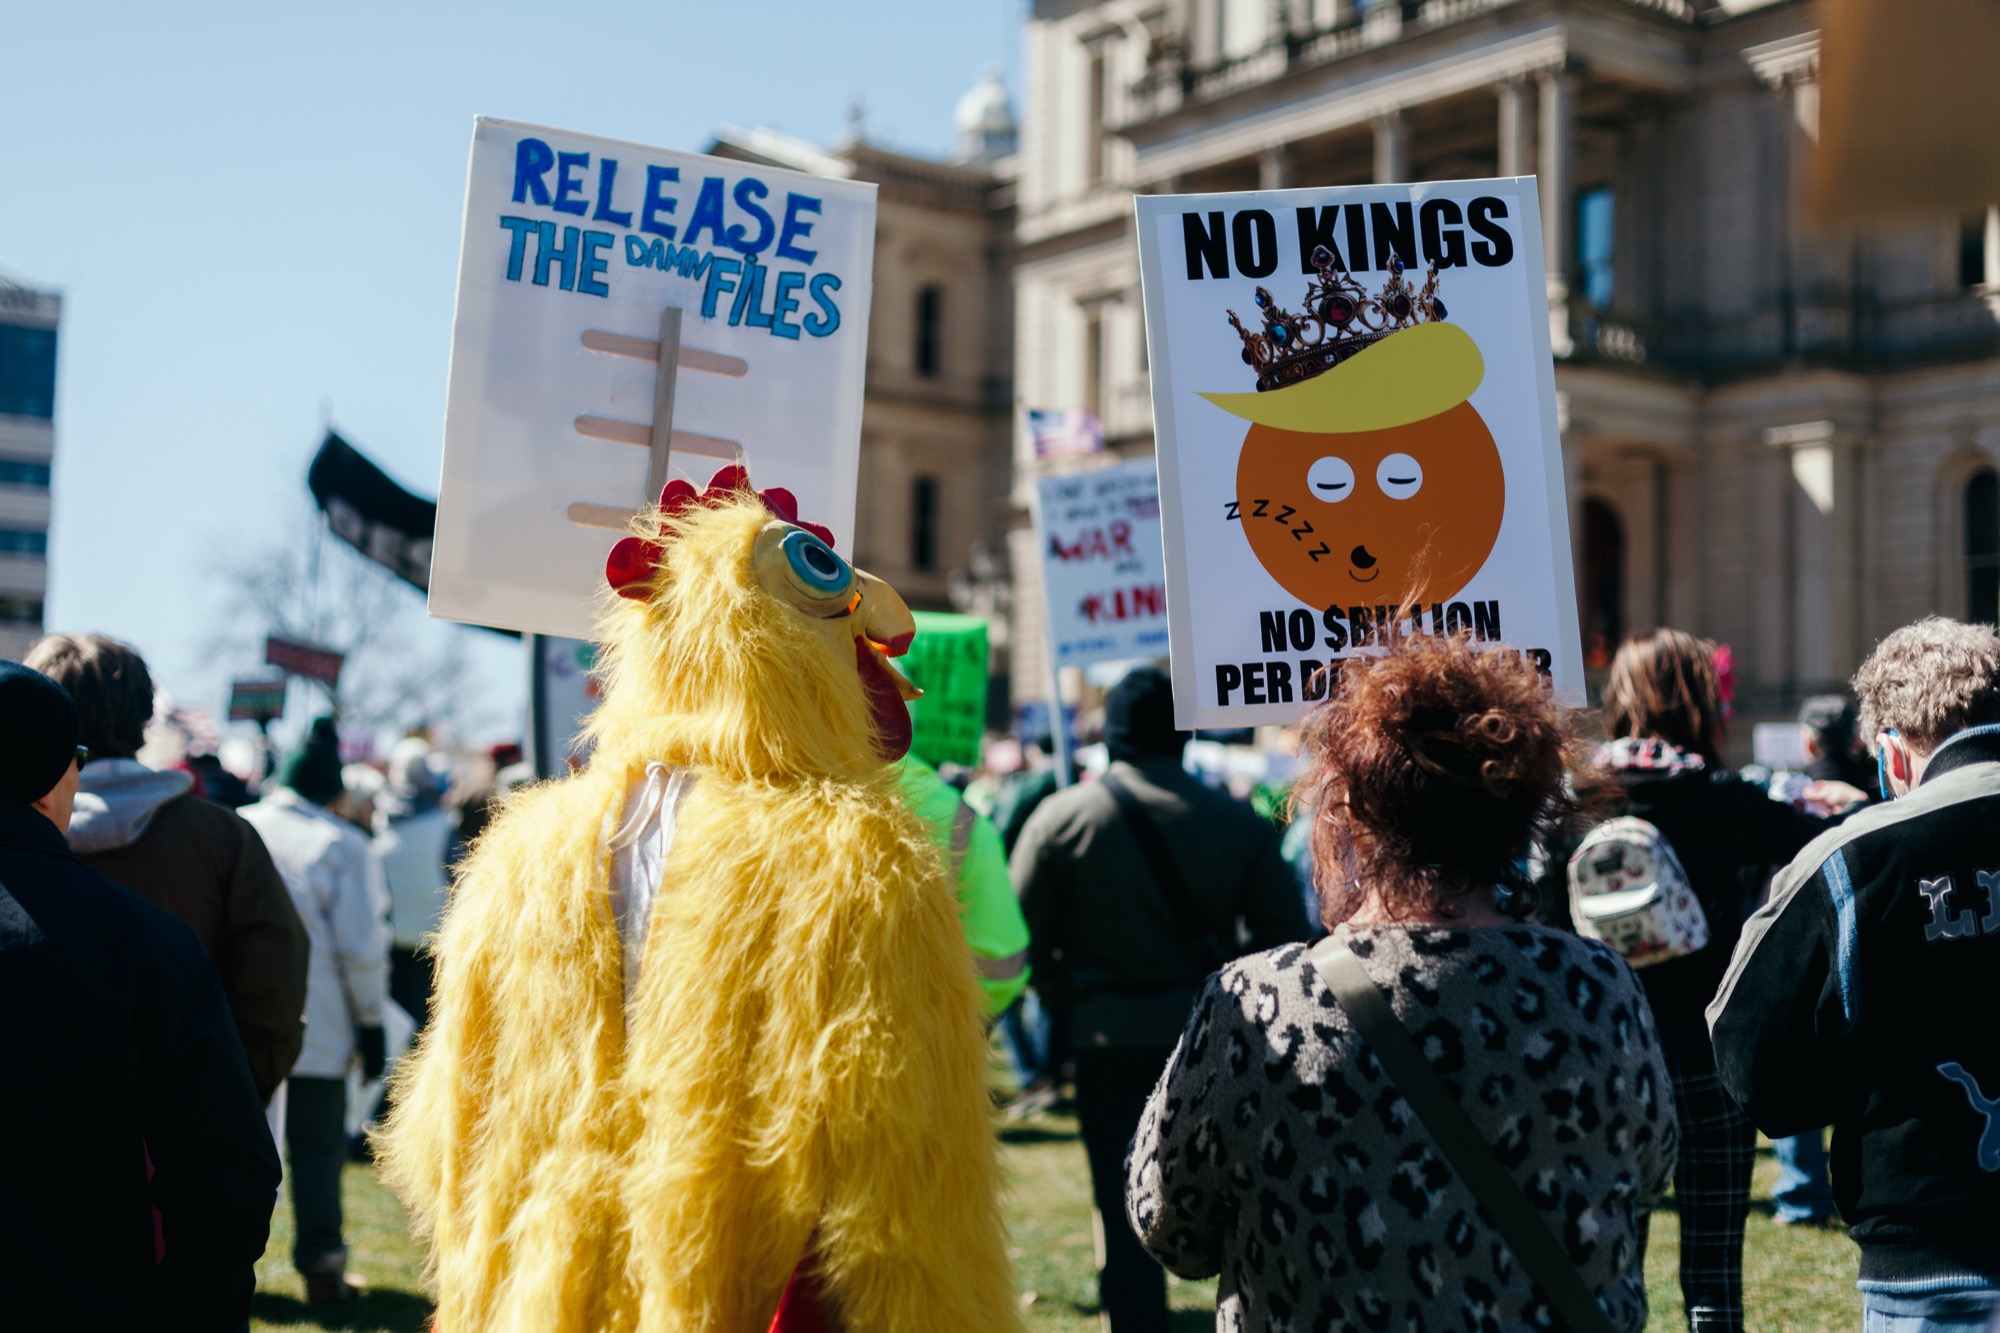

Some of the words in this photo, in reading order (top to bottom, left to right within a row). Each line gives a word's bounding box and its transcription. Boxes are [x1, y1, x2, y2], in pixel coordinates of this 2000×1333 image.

[511, 138, 822, 265] RELEASE
[1183, 209, 1278, 280] NO
[1296, 196, 1514, 275] KINGS
[500, 215, 615, 298] THE
[624, 234, 714, 281] DAMN
[1260, 608, 1315, 653] NO
[1216, 661, 1293, 707] PER
